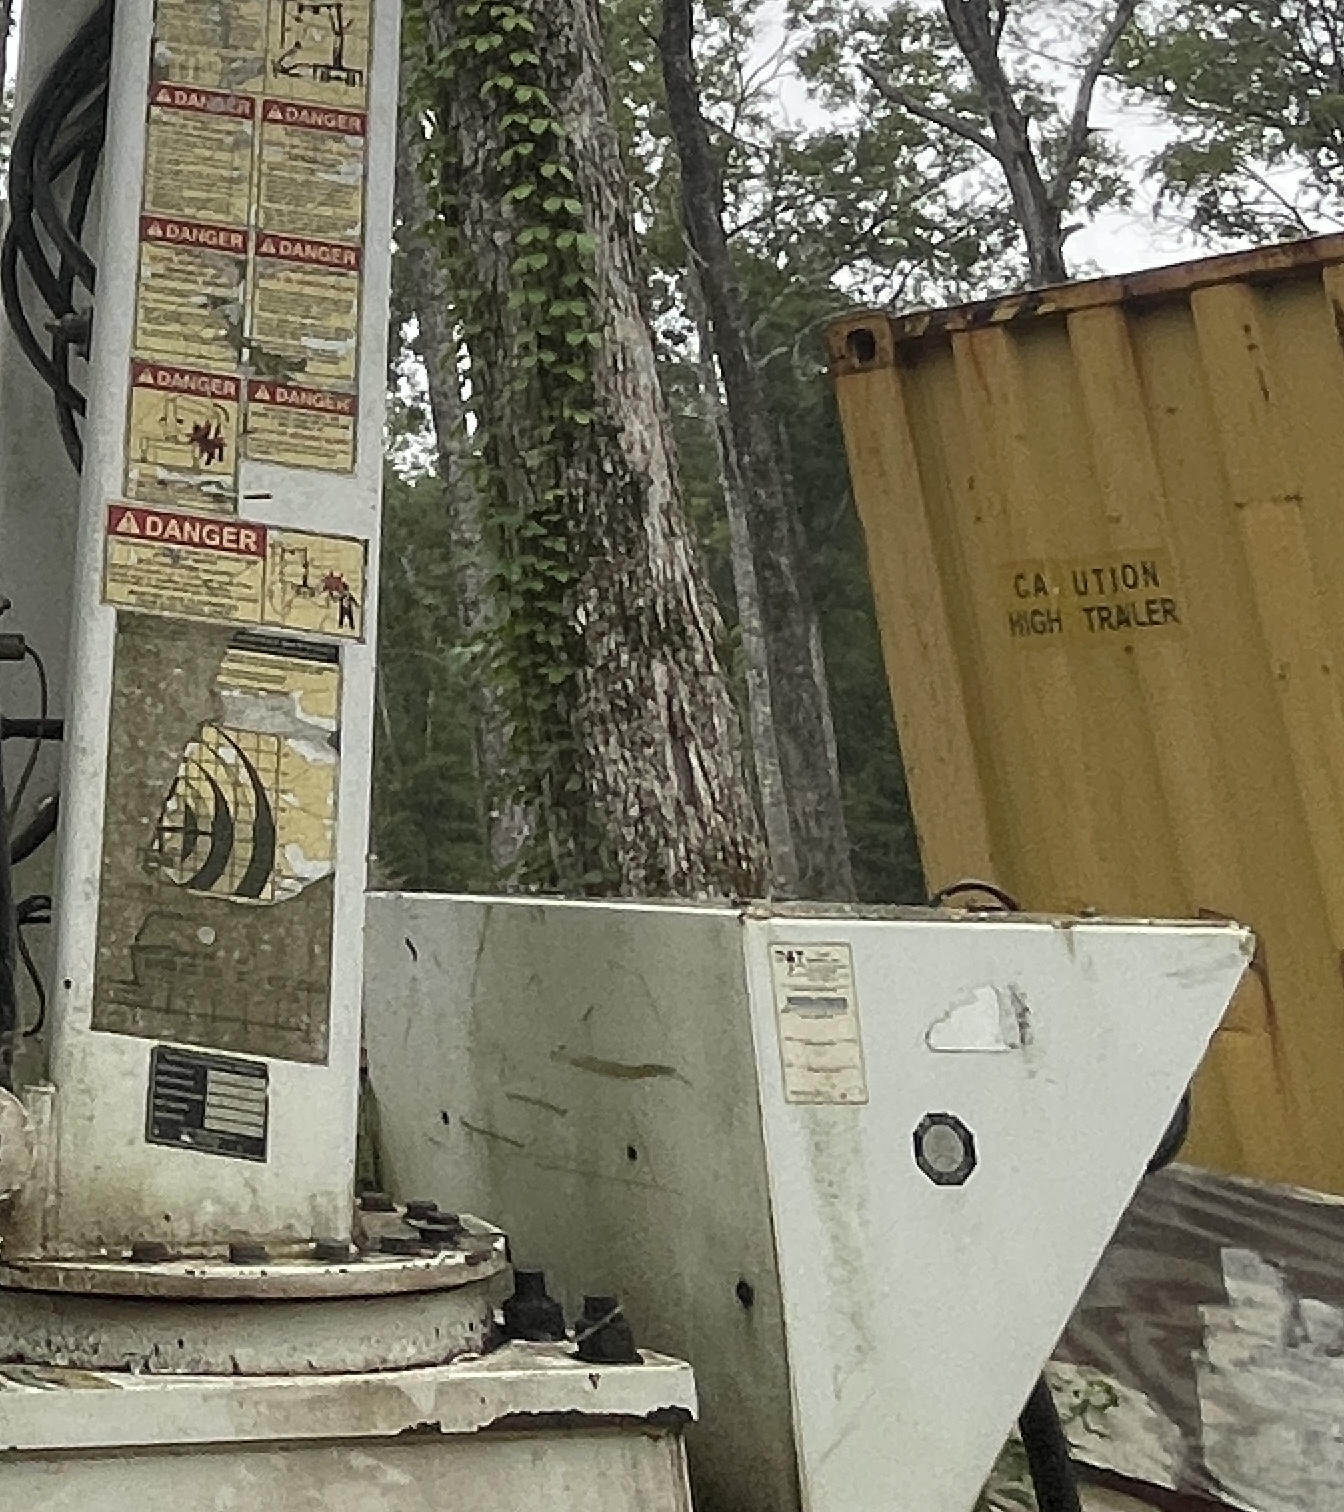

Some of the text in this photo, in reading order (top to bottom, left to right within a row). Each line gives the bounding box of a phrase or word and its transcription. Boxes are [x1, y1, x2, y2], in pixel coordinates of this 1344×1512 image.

[286, 106, 362, 133] DANGER
[166, 222, 244, 249] DANGER
[279, 239, 356, 266] DANGER
[156, 370, 236, 397] DANGER
[276, 386, 352, 412] DANGER
[145, 516, 258, 552] DANGER
[1008, 608, 1063, 637] HIGH
